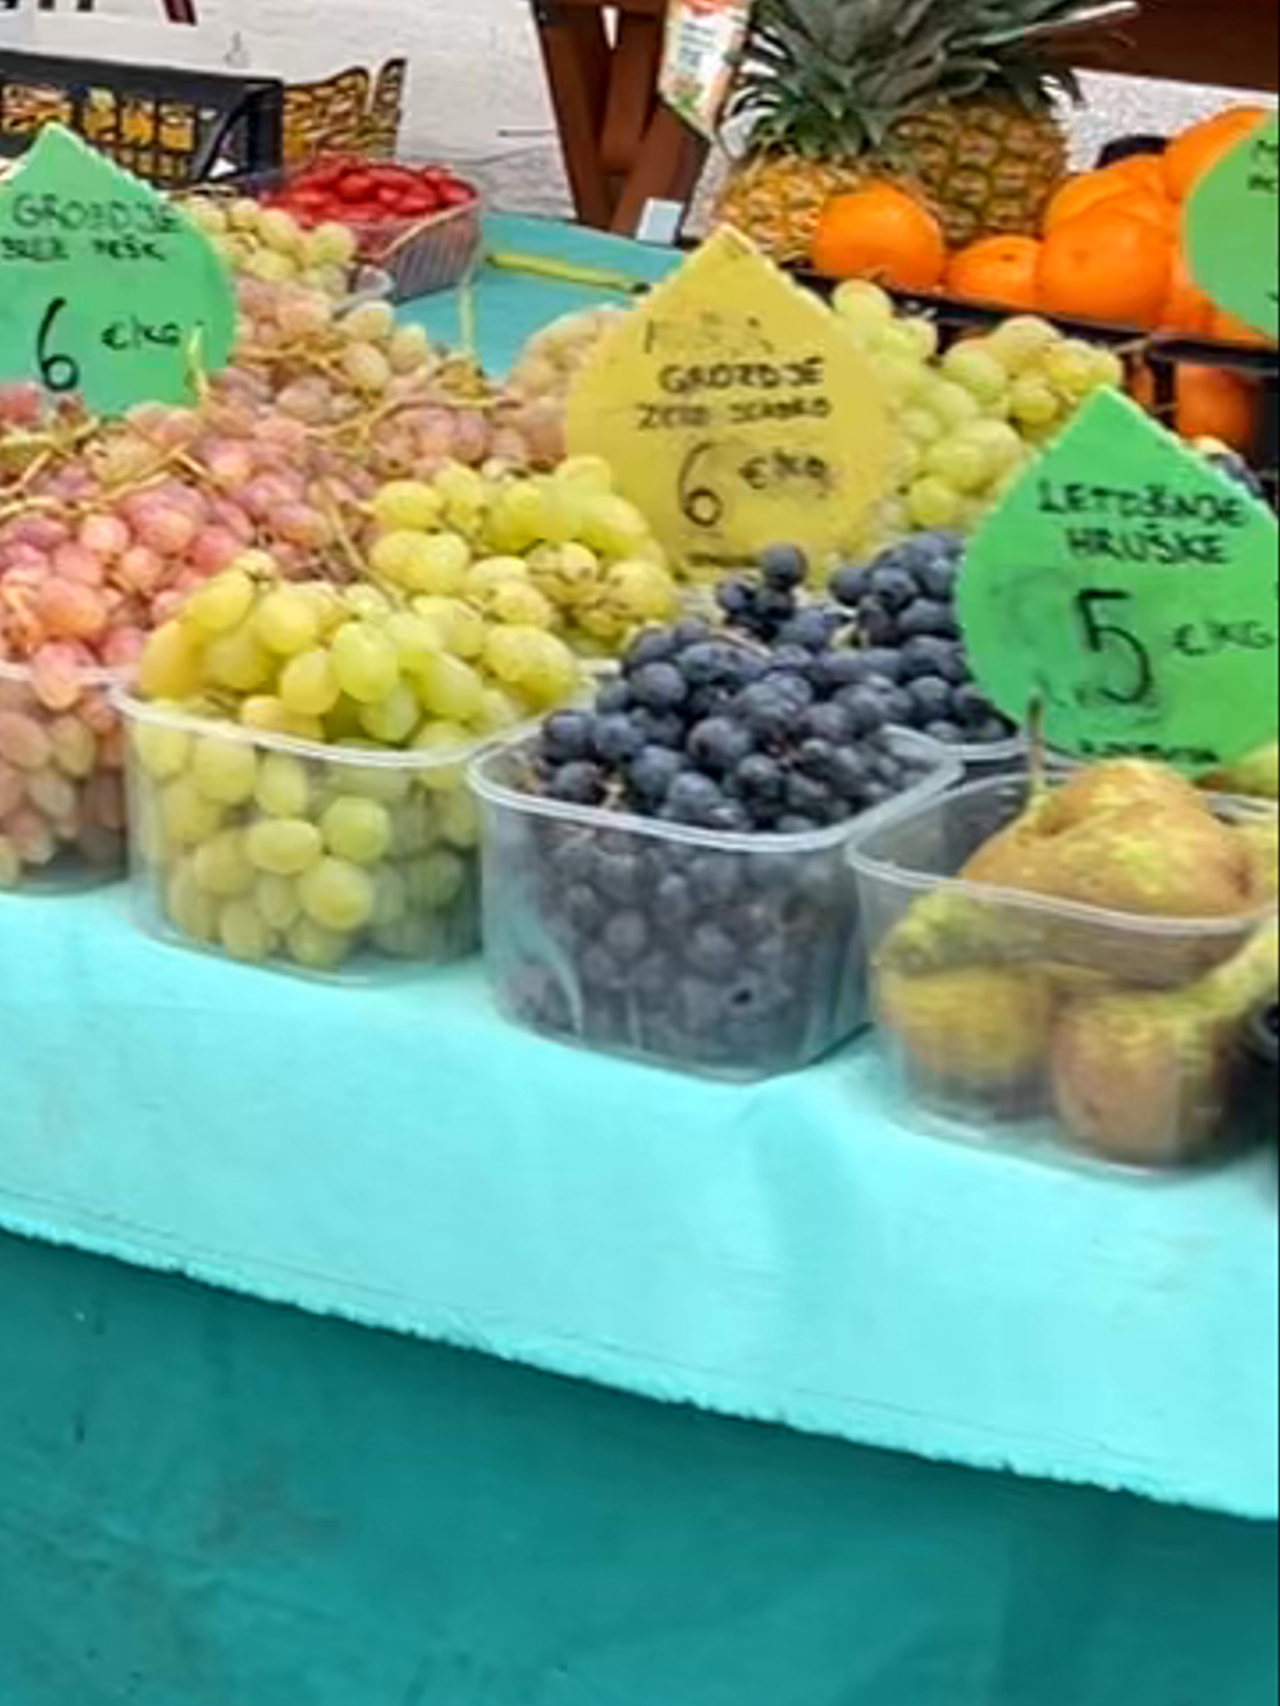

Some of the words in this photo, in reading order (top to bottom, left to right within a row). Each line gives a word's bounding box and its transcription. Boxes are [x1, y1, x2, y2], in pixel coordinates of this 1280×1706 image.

[37, 296, 80, 393] 6
[657, 355, 826, 395] GROZDJE
[676, 439, 725, 528] 6
[1065, 522, 1229, 565] HRUŠKE
[1076, 588, 1155, 705] 5
